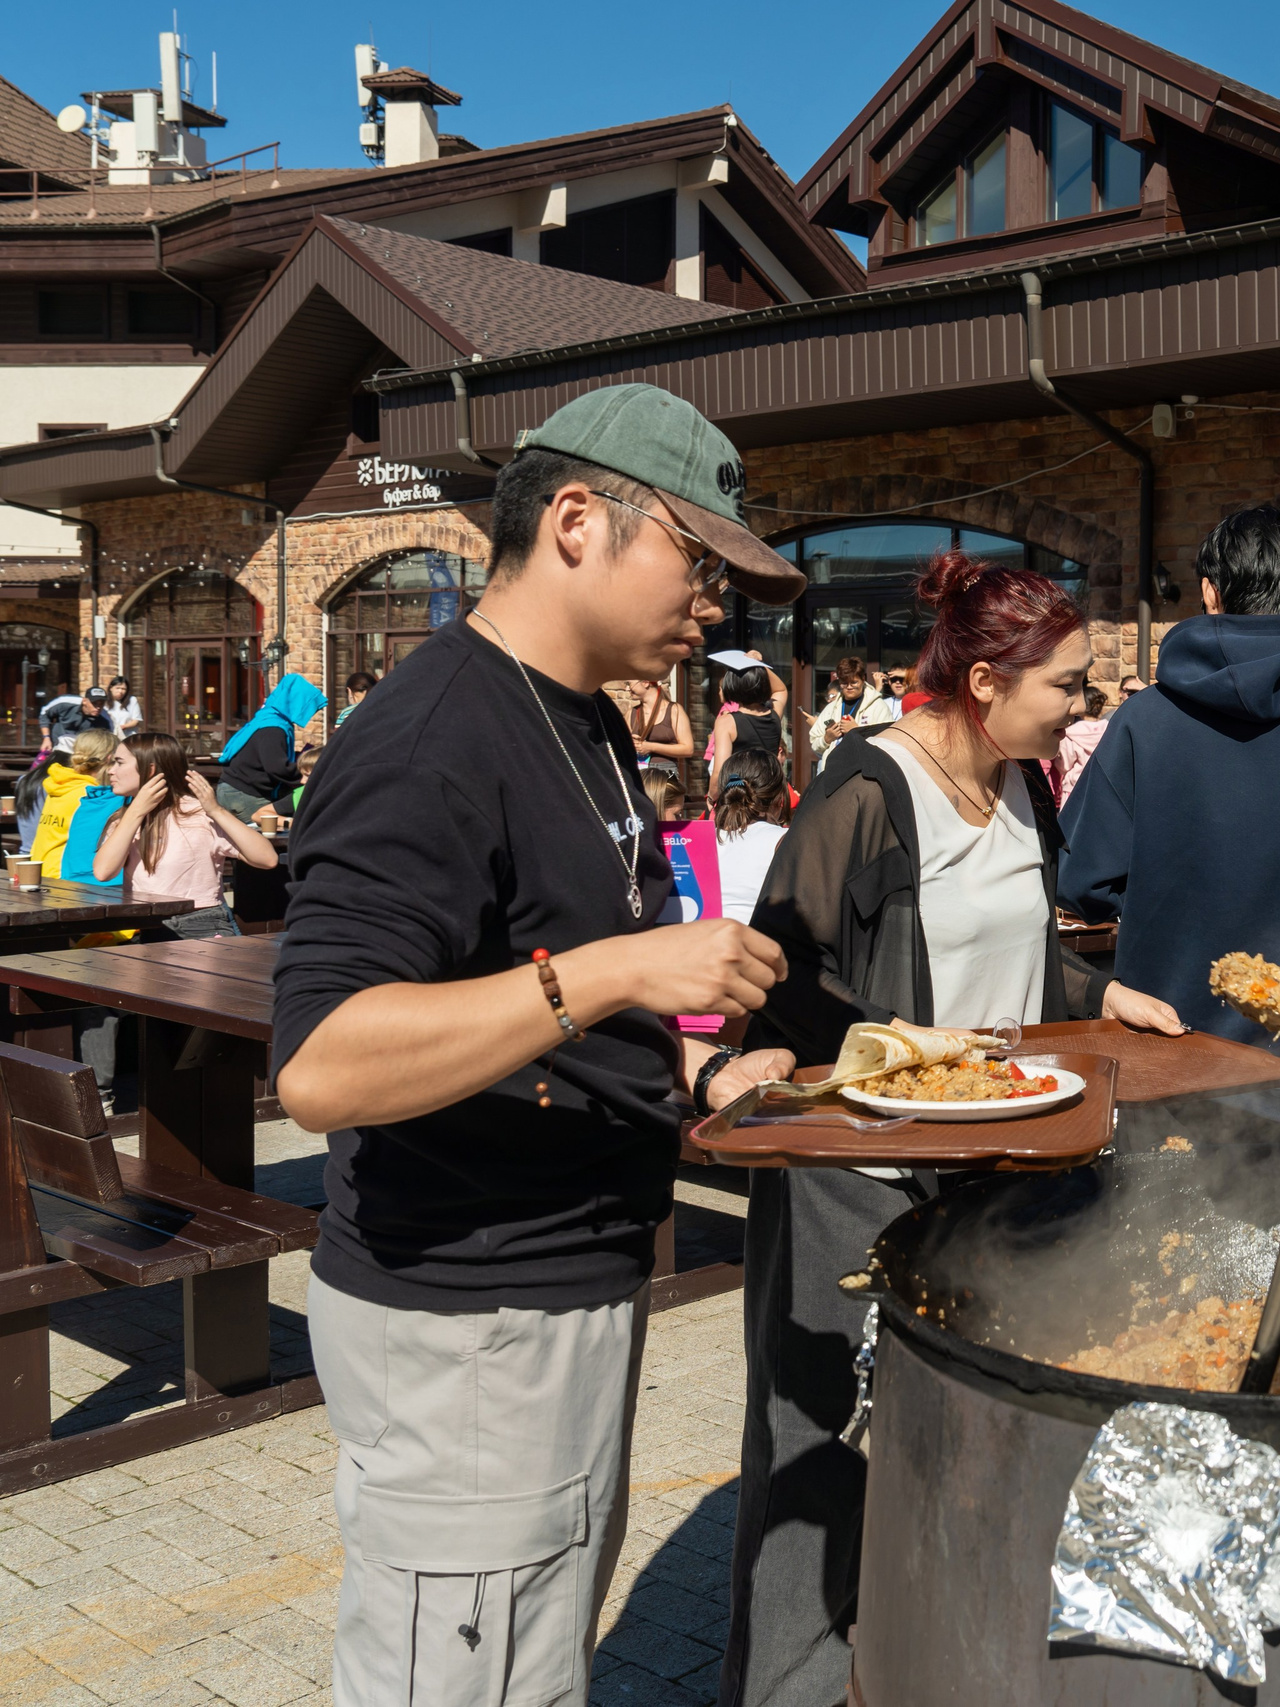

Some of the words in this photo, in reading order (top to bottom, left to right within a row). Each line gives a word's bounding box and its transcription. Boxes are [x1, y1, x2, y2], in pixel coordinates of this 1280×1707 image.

[383, 487, 413, 508] буфет
[413, 484, 422, 500] &
[422, 483, 441, 501] бар
